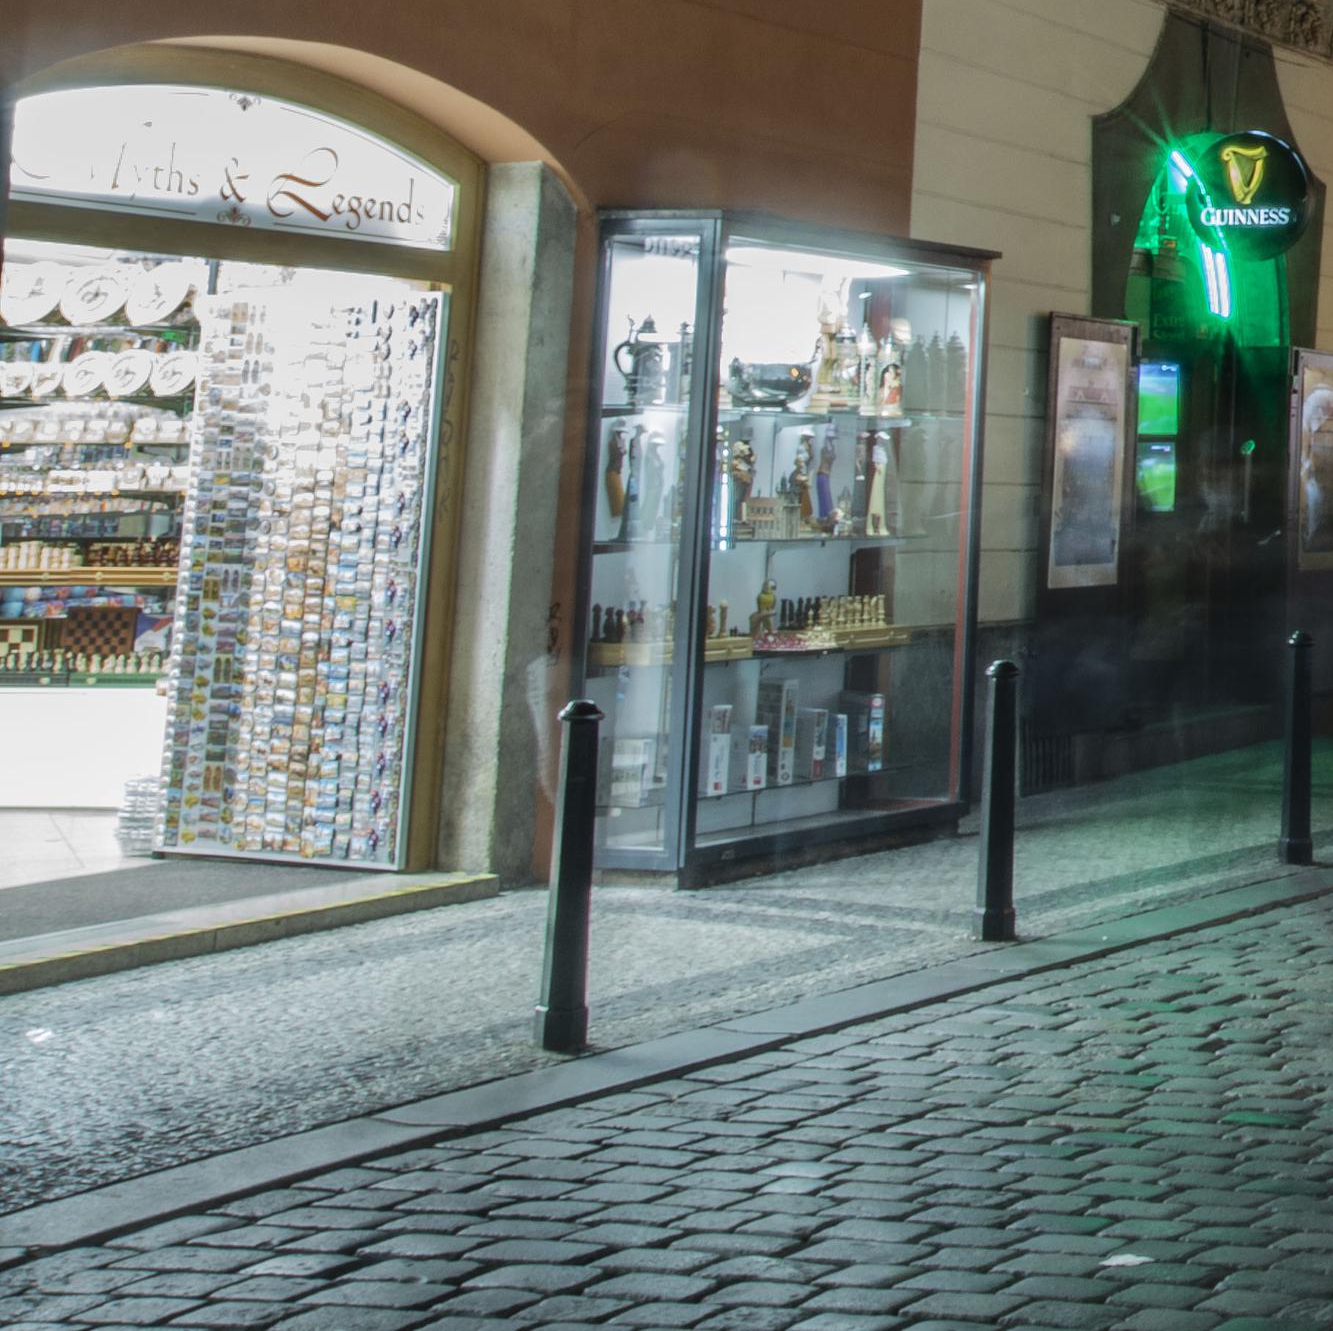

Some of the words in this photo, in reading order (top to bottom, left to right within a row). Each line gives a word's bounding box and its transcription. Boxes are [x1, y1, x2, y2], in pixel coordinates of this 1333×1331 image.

[219, 157, 250, 203] &
[266, 147, 425, 229] Legends
[1200, 207, 1290, 226] GUINNESS
